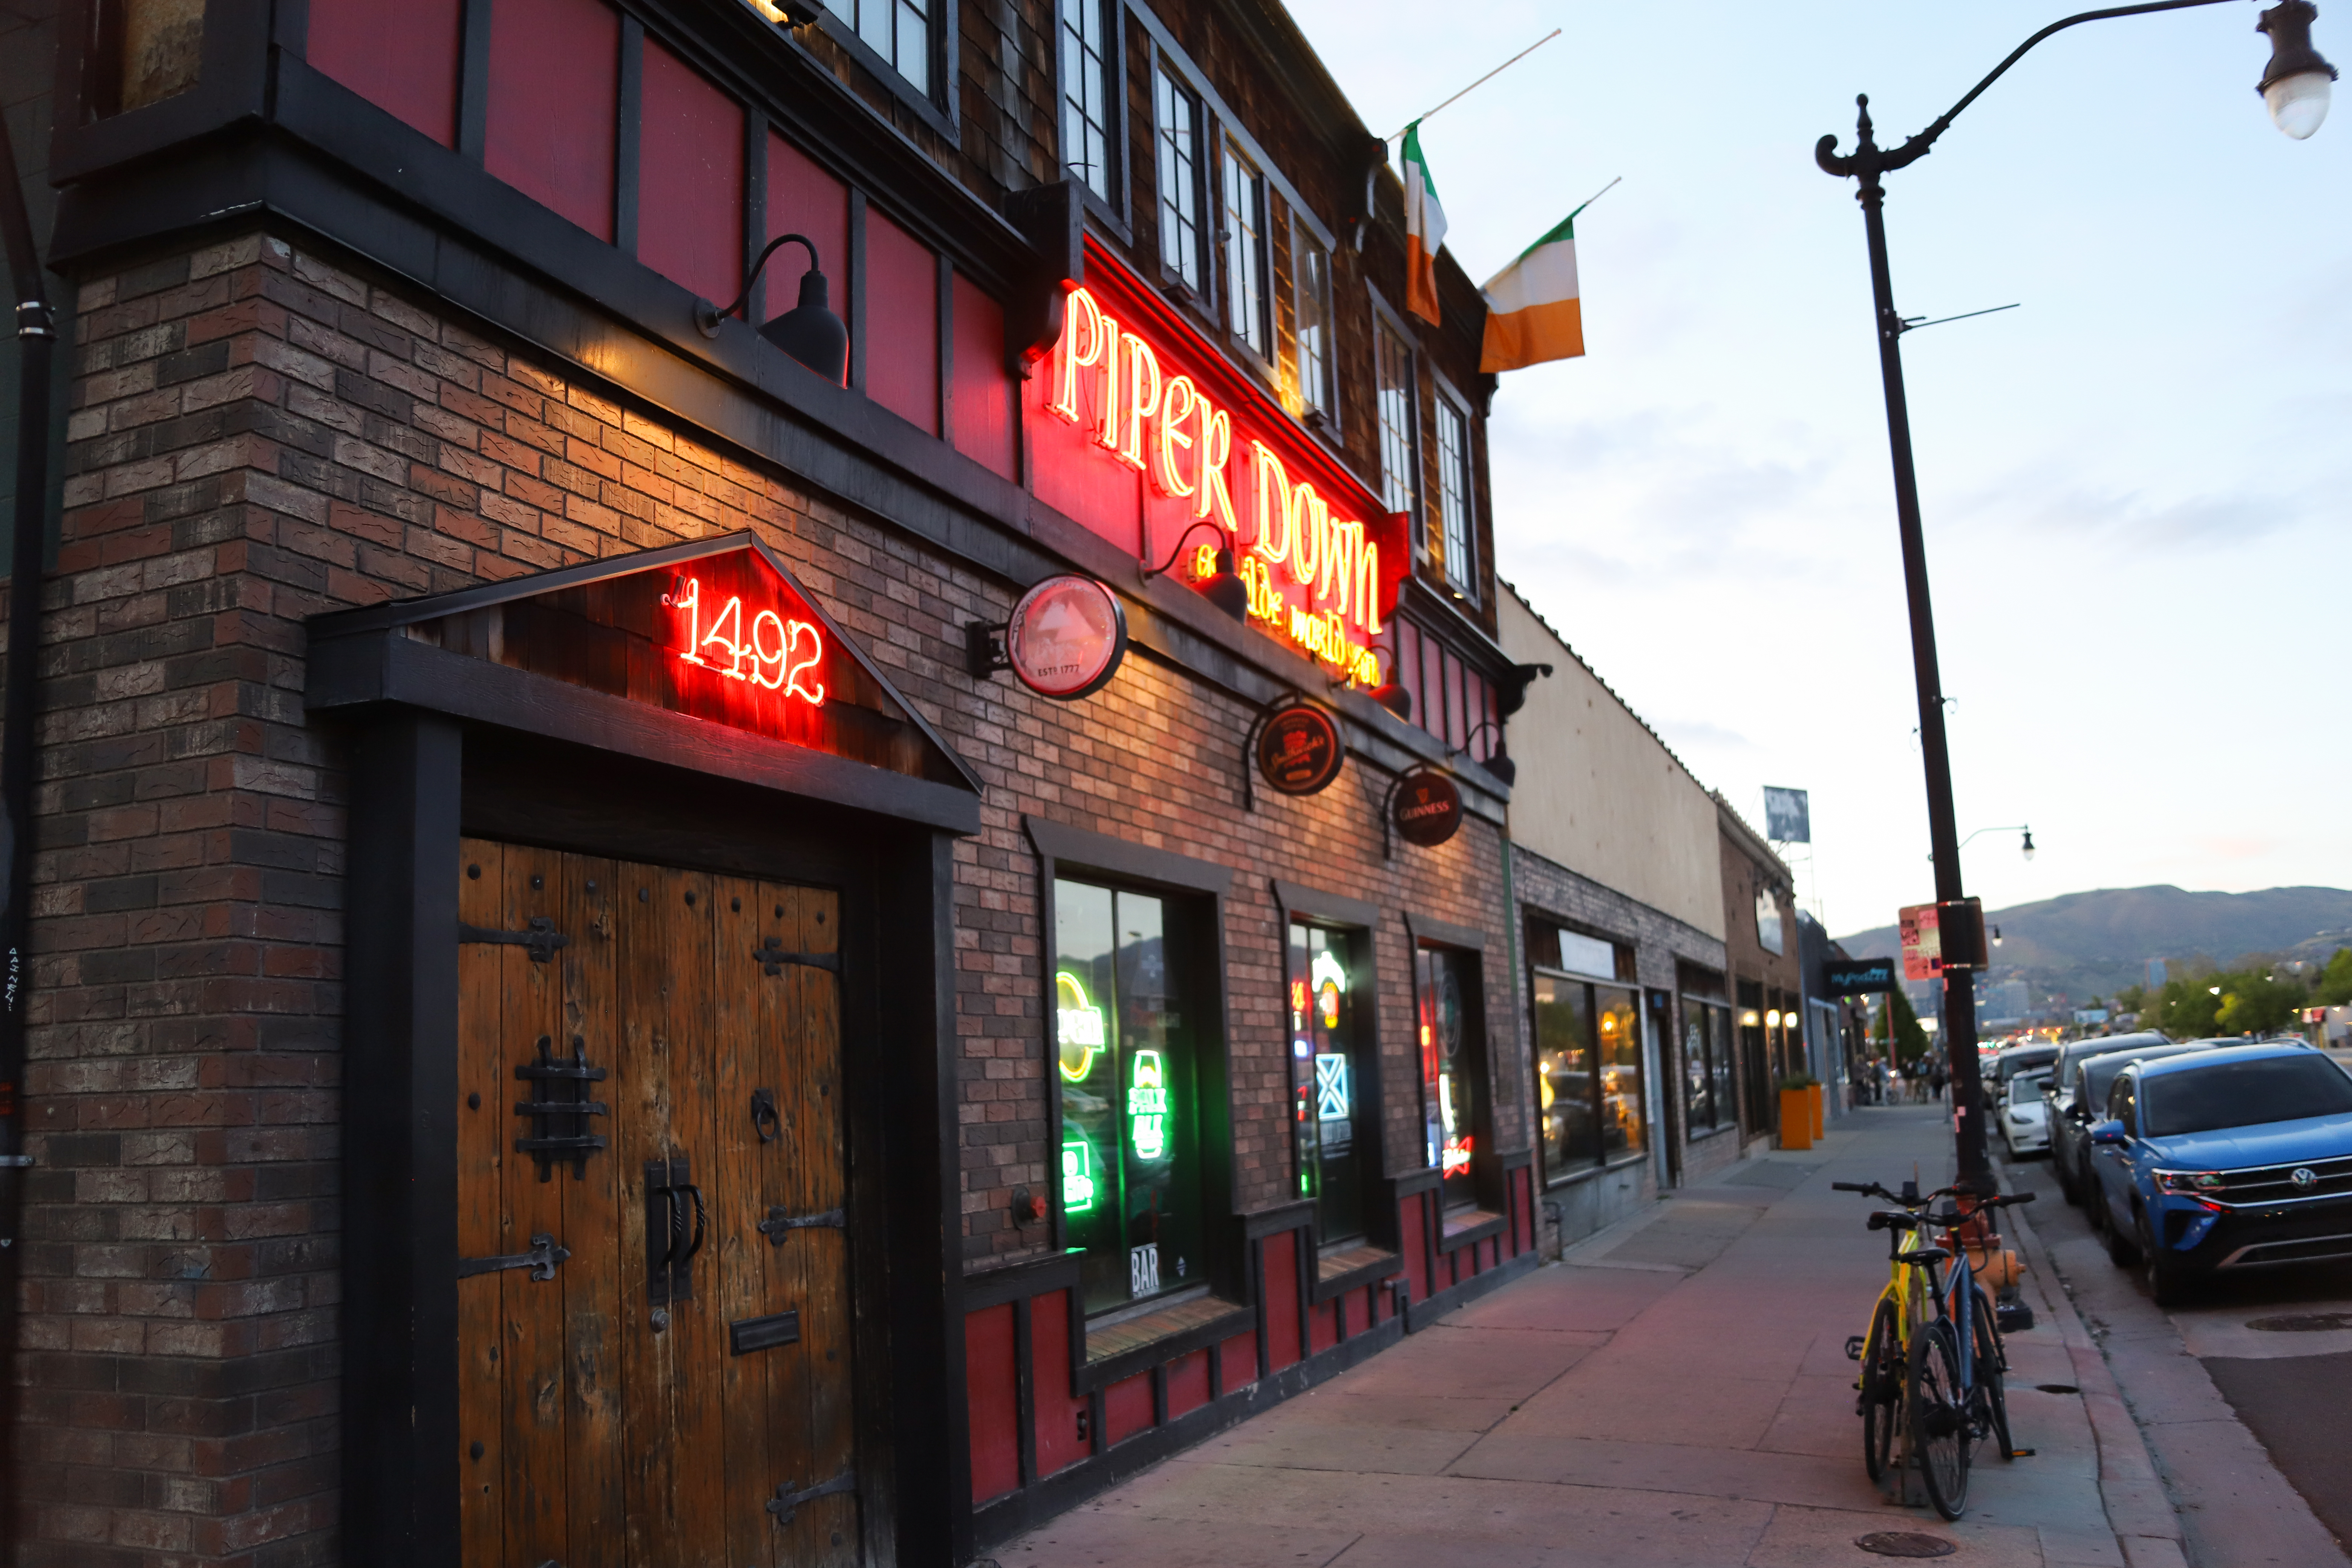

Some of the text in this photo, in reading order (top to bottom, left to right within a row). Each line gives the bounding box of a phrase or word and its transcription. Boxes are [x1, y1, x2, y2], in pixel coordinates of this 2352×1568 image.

[677, 577, 825, 705] 1492
[1061, 664, 1080, 674] 1777
[1399, 801, 1450, 821] GUINNESS
[1131, 1247, 1159, 1292] BAR
